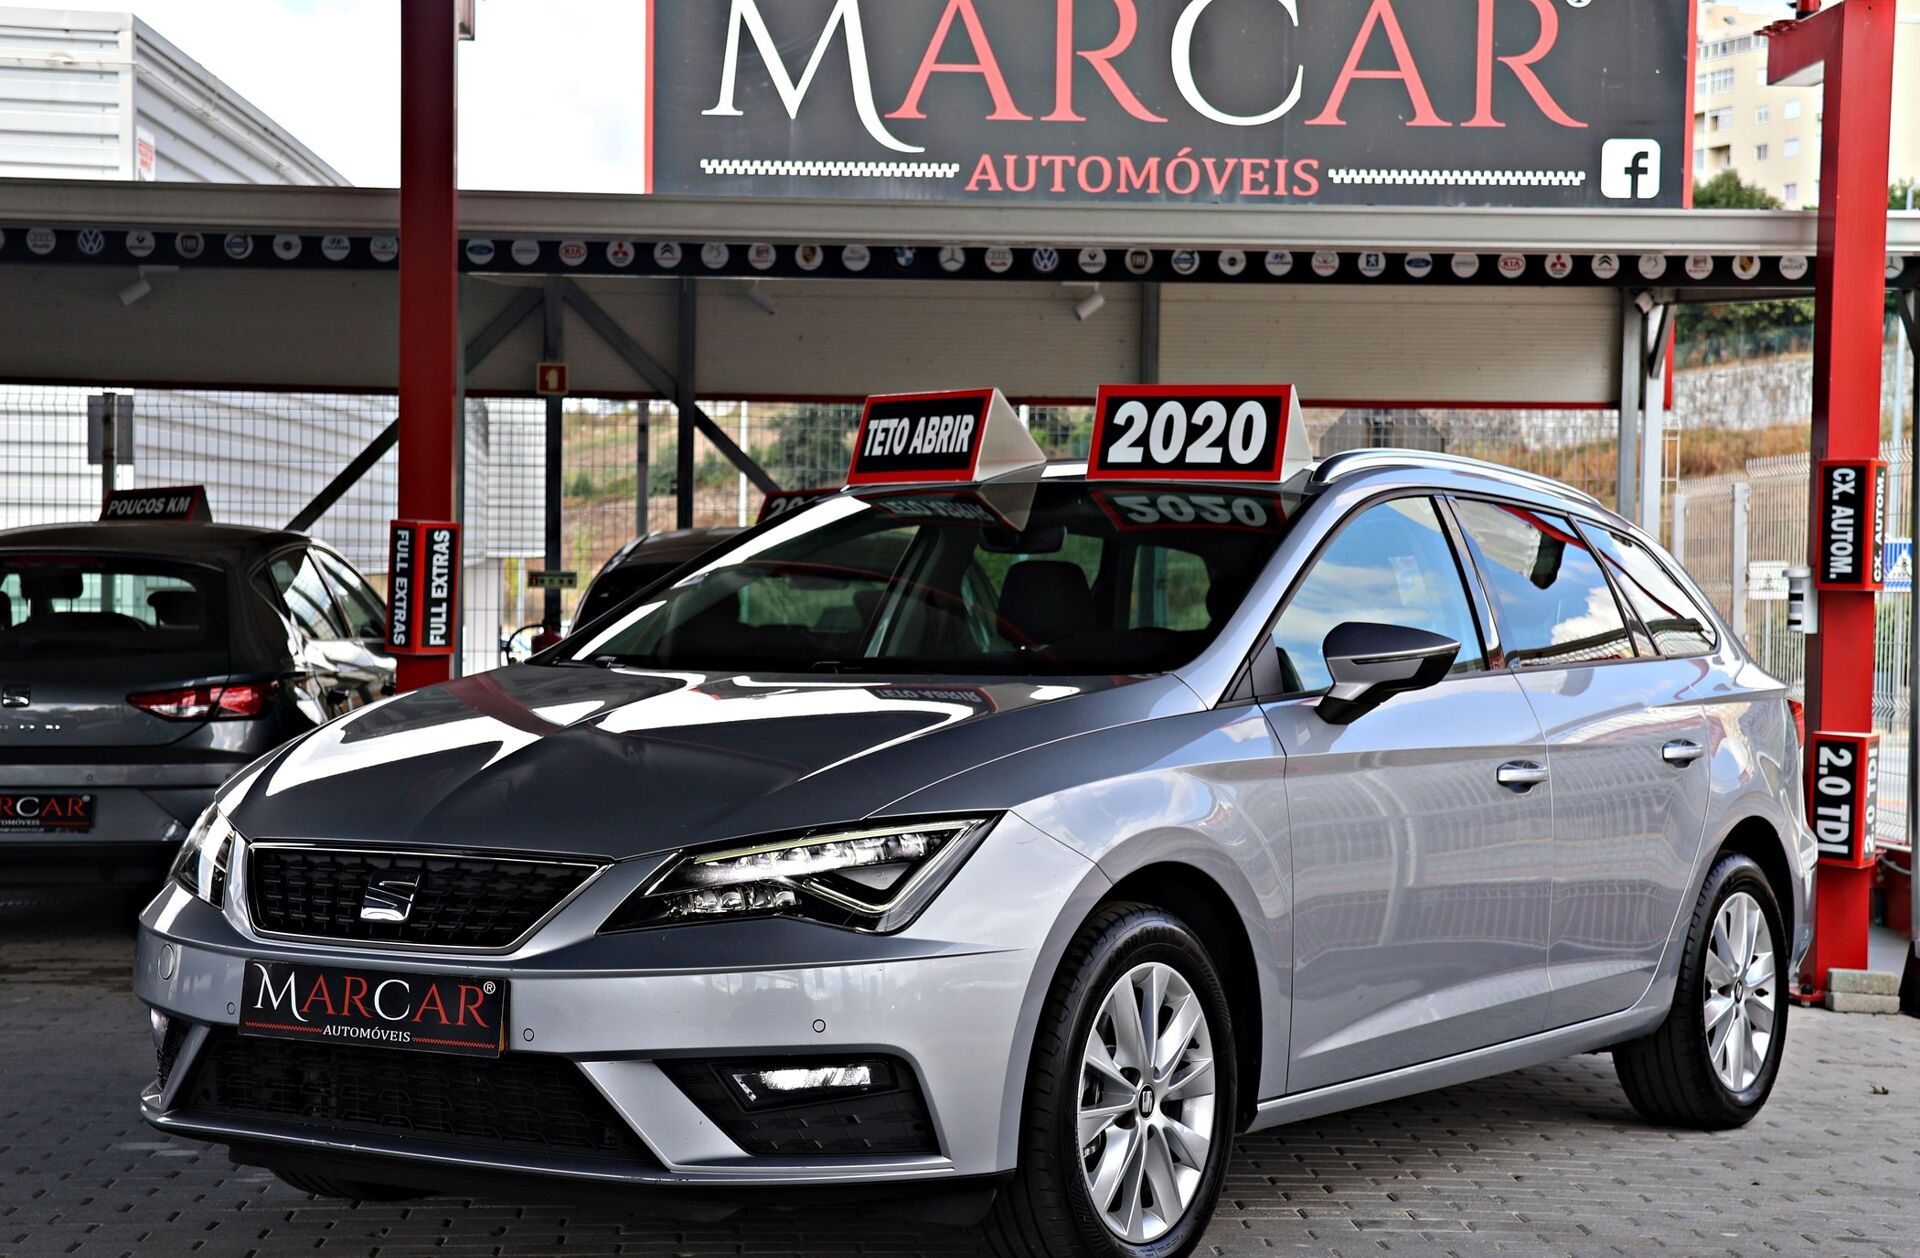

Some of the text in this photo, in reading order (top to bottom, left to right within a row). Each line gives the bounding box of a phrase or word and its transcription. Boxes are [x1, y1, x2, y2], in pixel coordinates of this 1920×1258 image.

[701, 0, 1589, 154] MARCAR
[965, 148, 1320, 197] AUTOMÓVEIS
[864, 413, 975, 457] TETO ABRIR
[1107, 400, 1268, 464] 2020
[107, 497, 192, 516] POUCOS KM
[1829, 468, 1856, 580] CX. AUTOM.
[393, 529, 409, 645] FULL EXTRAS
[429, 530, 450, 646] FULL EXTRAS
[1815, 746, 1853, 854] 2.0 TDI
[252, 962, 490, 1029] MARCAR
[322, 1023, 412, 1043] AUTOMÓVEIS
